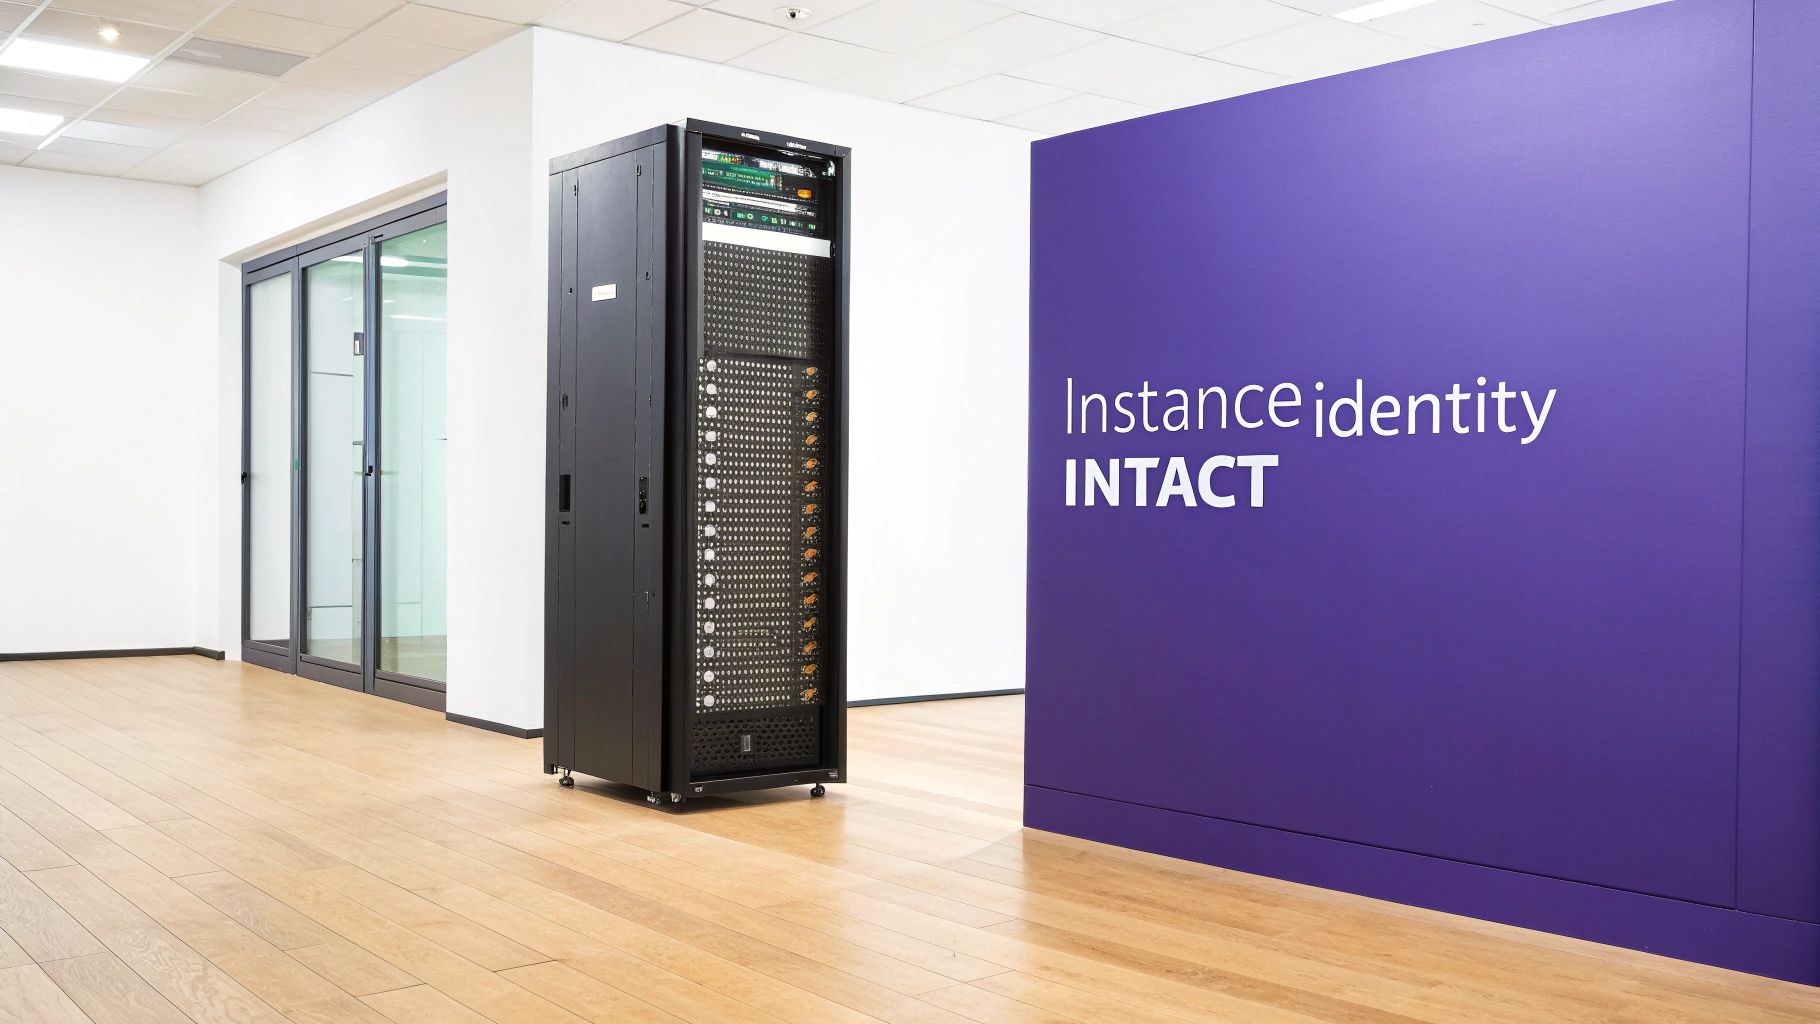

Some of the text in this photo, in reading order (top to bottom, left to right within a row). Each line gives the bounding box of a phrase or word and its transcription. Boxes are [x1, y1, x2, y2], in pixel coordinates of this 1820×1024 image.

[1066, 376, 1557, 445] Instance identity
[1066, 454, 1279, 508] INTACT
